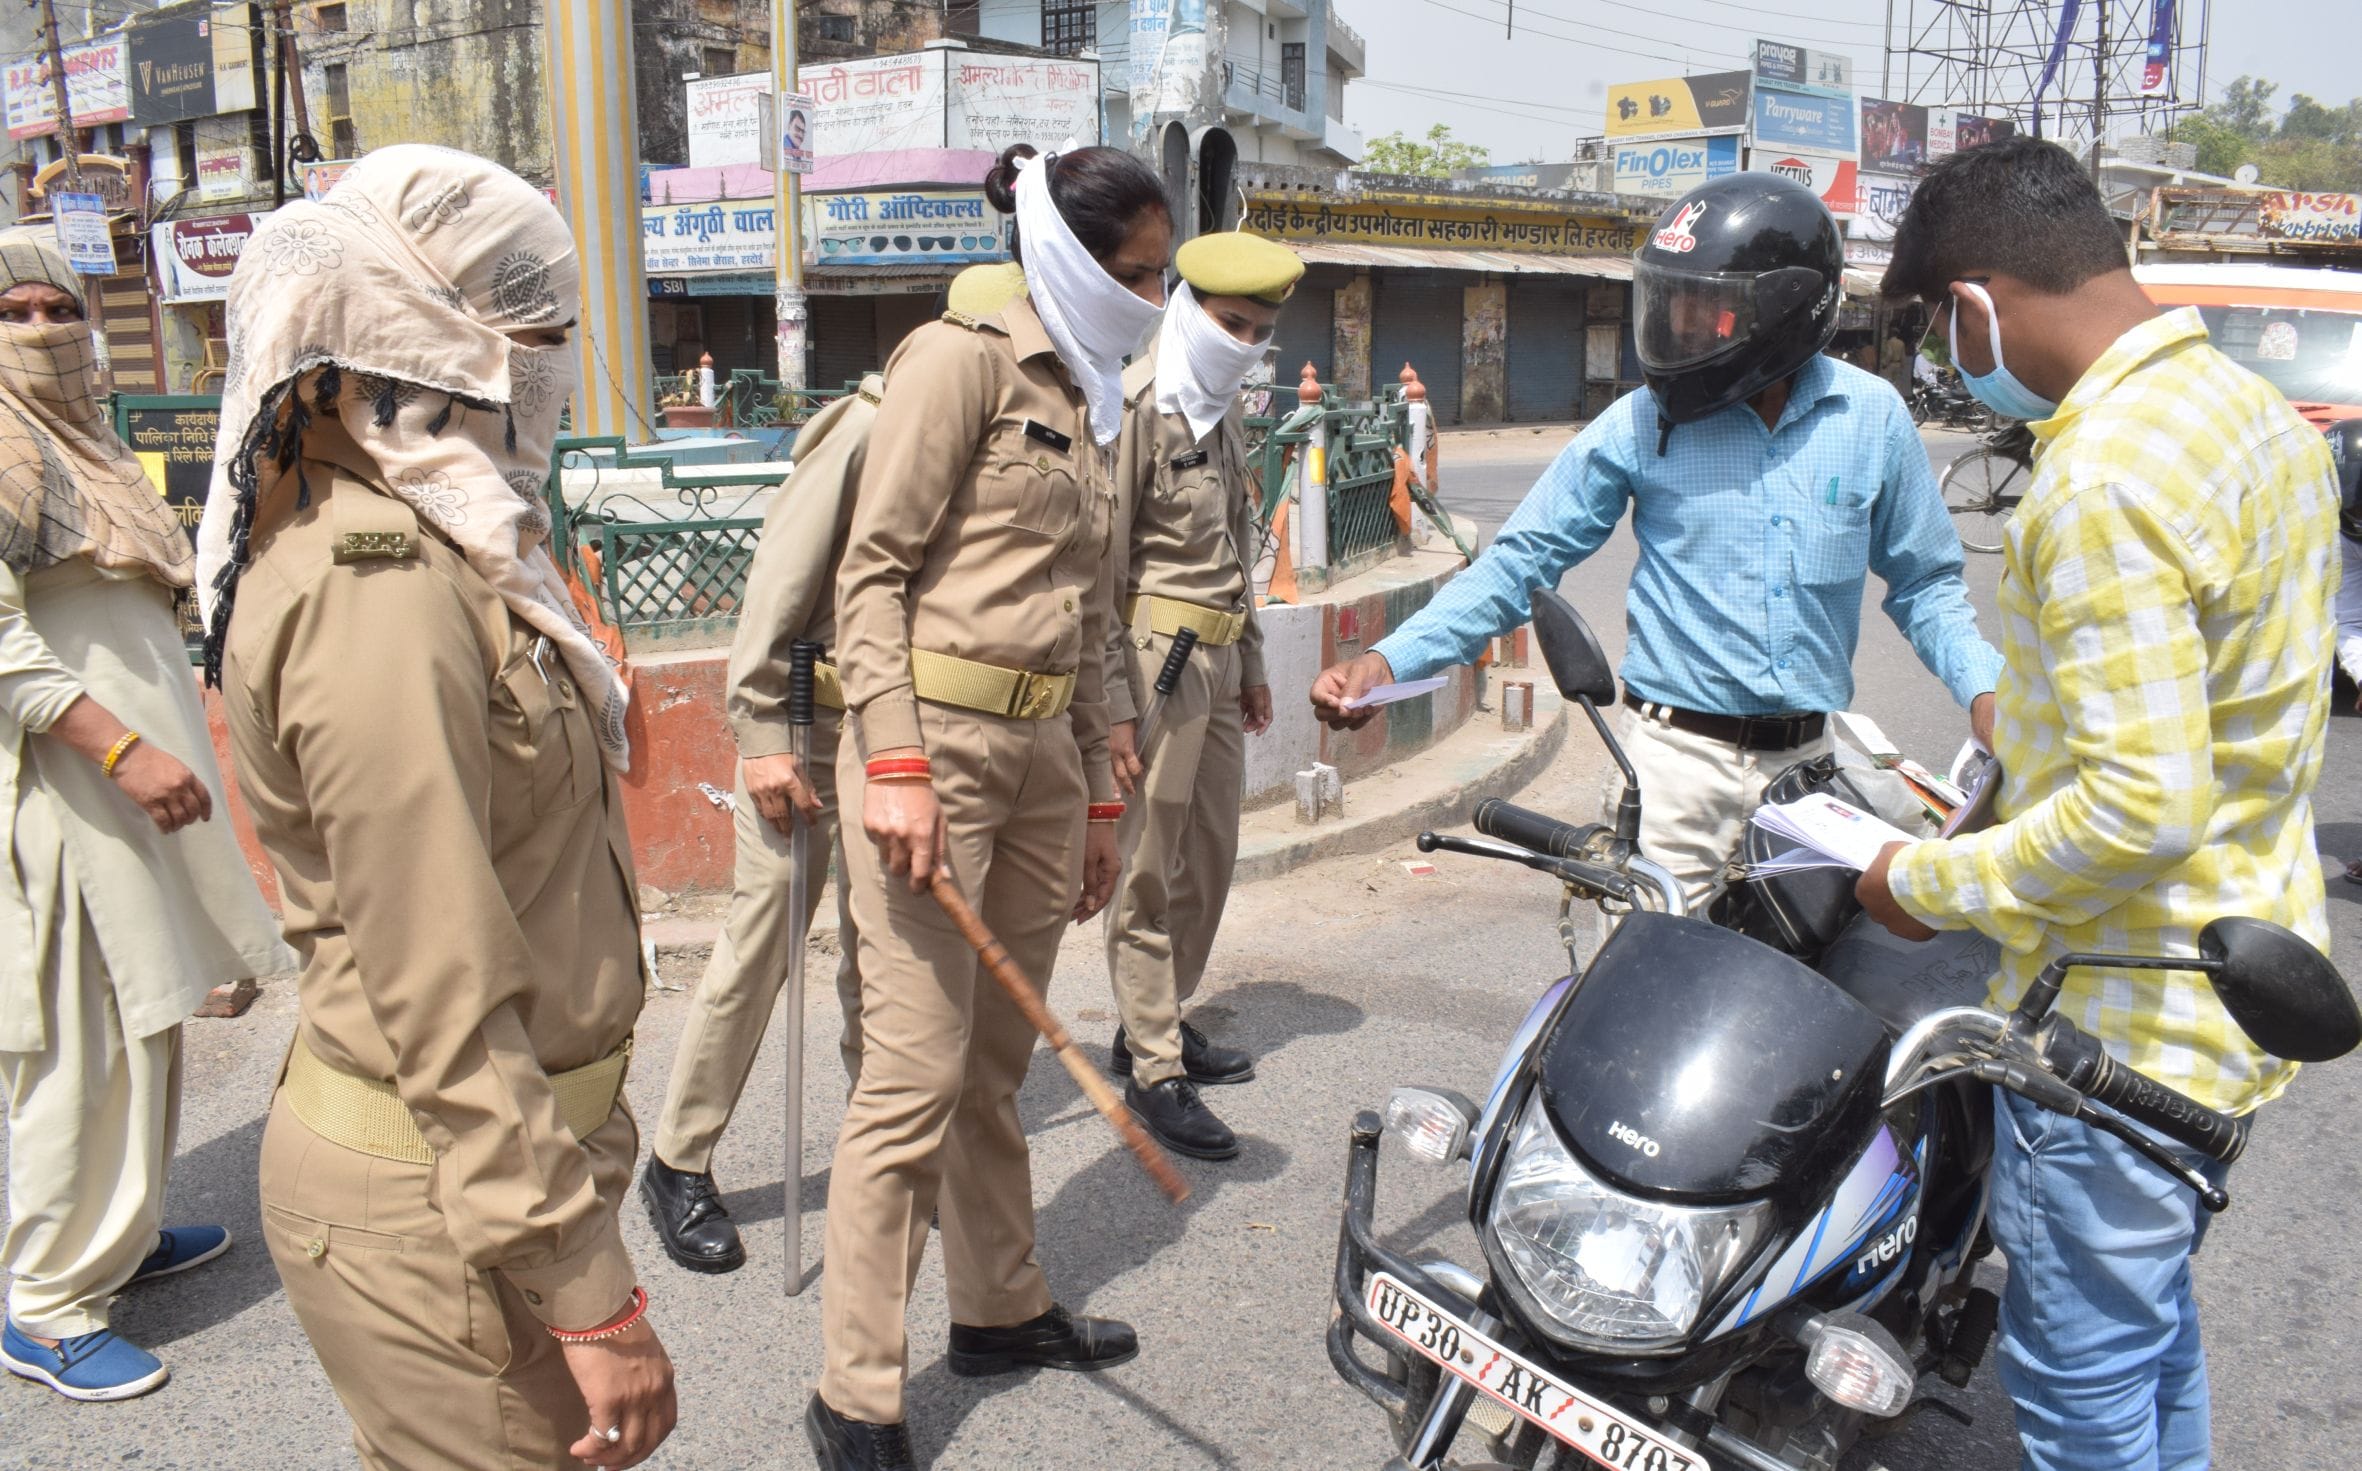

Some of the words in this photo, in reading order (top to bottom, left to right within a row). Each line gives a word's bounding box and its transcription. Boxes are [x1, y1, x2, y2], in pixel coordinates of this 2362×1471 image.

[1765, 96, 1823, 124] Parryware
[1641, 178, 1673, 189] PIPES
[827, 195, 870, 221] गौरी
[2264, 191, 2358, 215] Arsh
[733, 208, 775, 233] वाल
[1242, 201, 1288, 234] रदोई
[1289, 204, 1348, 236] केन्द्रीय
[1427, 216, 1498, 242] सहकारी
[1502, 223, 1561, 245] भण्डार
[1654, 229, 1696, 252] Hero
[663, 280, 684, 294] SBI
[133, 426, 180, 446] पालिका
[181, 426, 209, 444] निधि
[1607, 1120, 1661, 1158] Hero
[1856, 1214, 1917, 1276] Hero
[1495, 1362, 1553, 1417] AK
